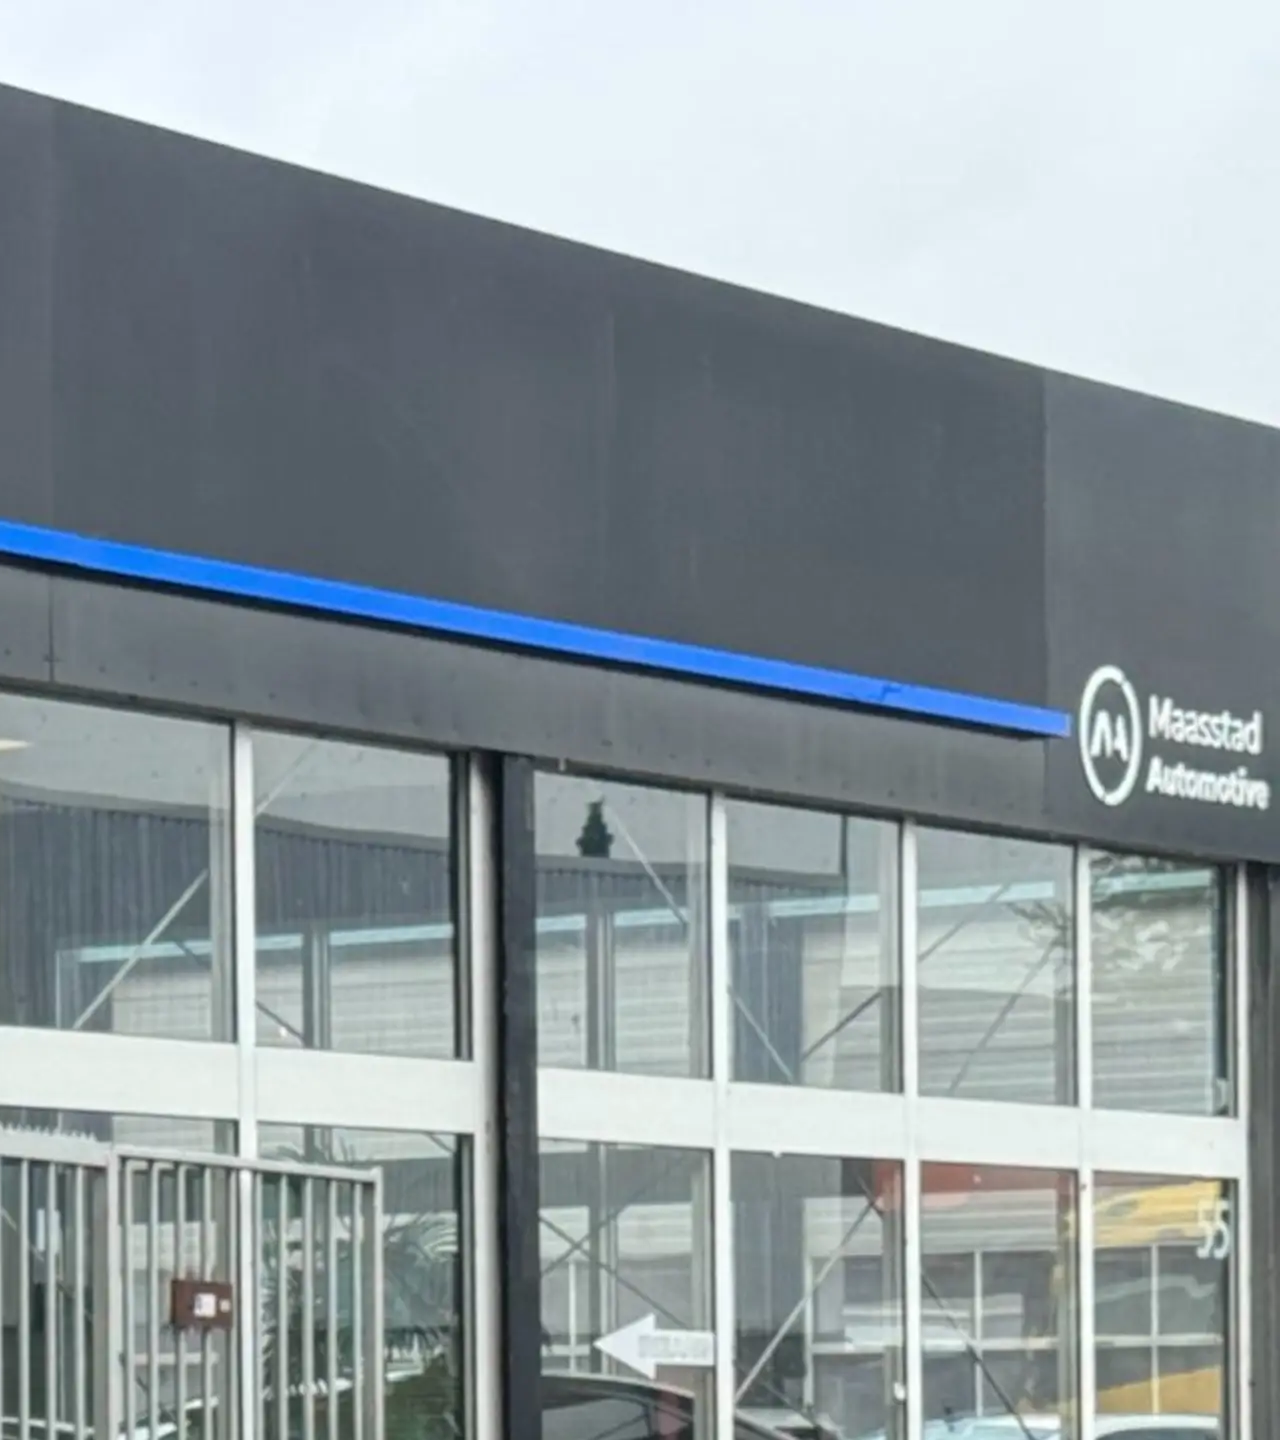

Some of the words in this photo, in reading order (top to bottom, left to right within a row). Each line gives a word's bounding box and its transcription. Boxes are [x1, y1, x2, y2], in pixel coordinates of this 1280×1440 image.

[1148, 694, 1263, 755] Maasstad
[1145, 755, 1271, 812] Automotive
[1196, 1199, 1230, 1260] 55
